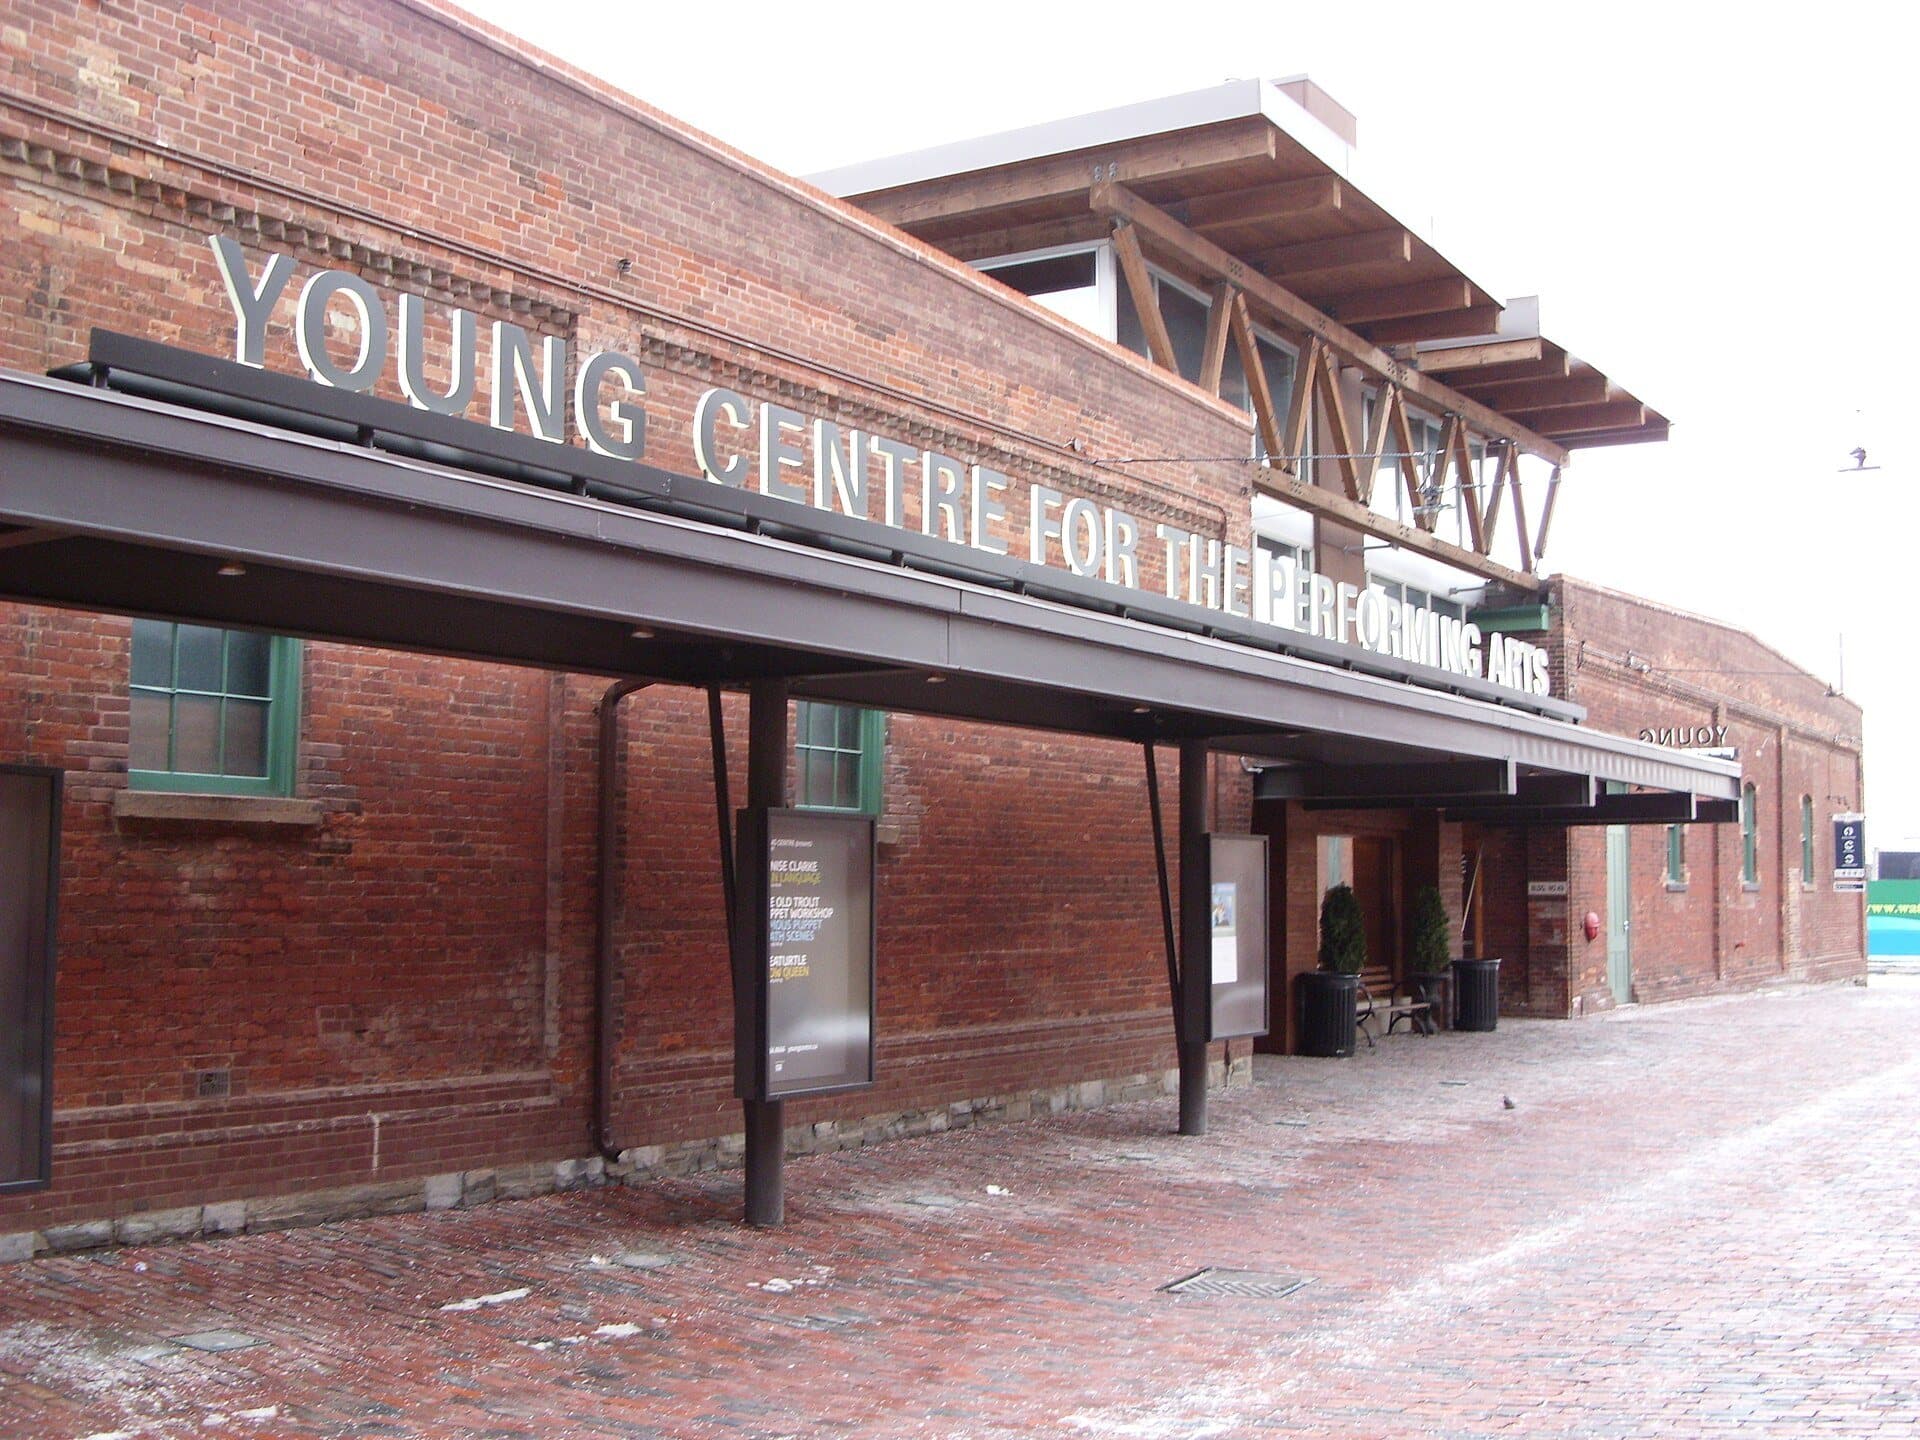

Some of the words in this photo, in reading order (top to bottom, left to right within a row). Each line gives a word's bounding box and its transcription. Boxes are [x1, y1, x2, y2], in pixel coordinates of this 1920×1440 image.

[208, 234, 646, 461] YOUNG
[693, 387, 1009, 556] CENTRE
[1029, 484, 1139, 589] FOR
[1157, 524, 1249, 618] THE
[1257, 552, 1482, 679] PERFORMING
[1487, 631, 1550, 697] ARTS
[789, 860, 819, 872] CLARKE
[776, 897, 792, 908] OLD
[793, 896, 820, 908] TROUT
[790, 907, 834, 919] WORKSHOP
[791, 919, 823, 930] PUPPET
[786, 930, 815, 942] SCENES
[783, 966, 810, 980] QUEEN
